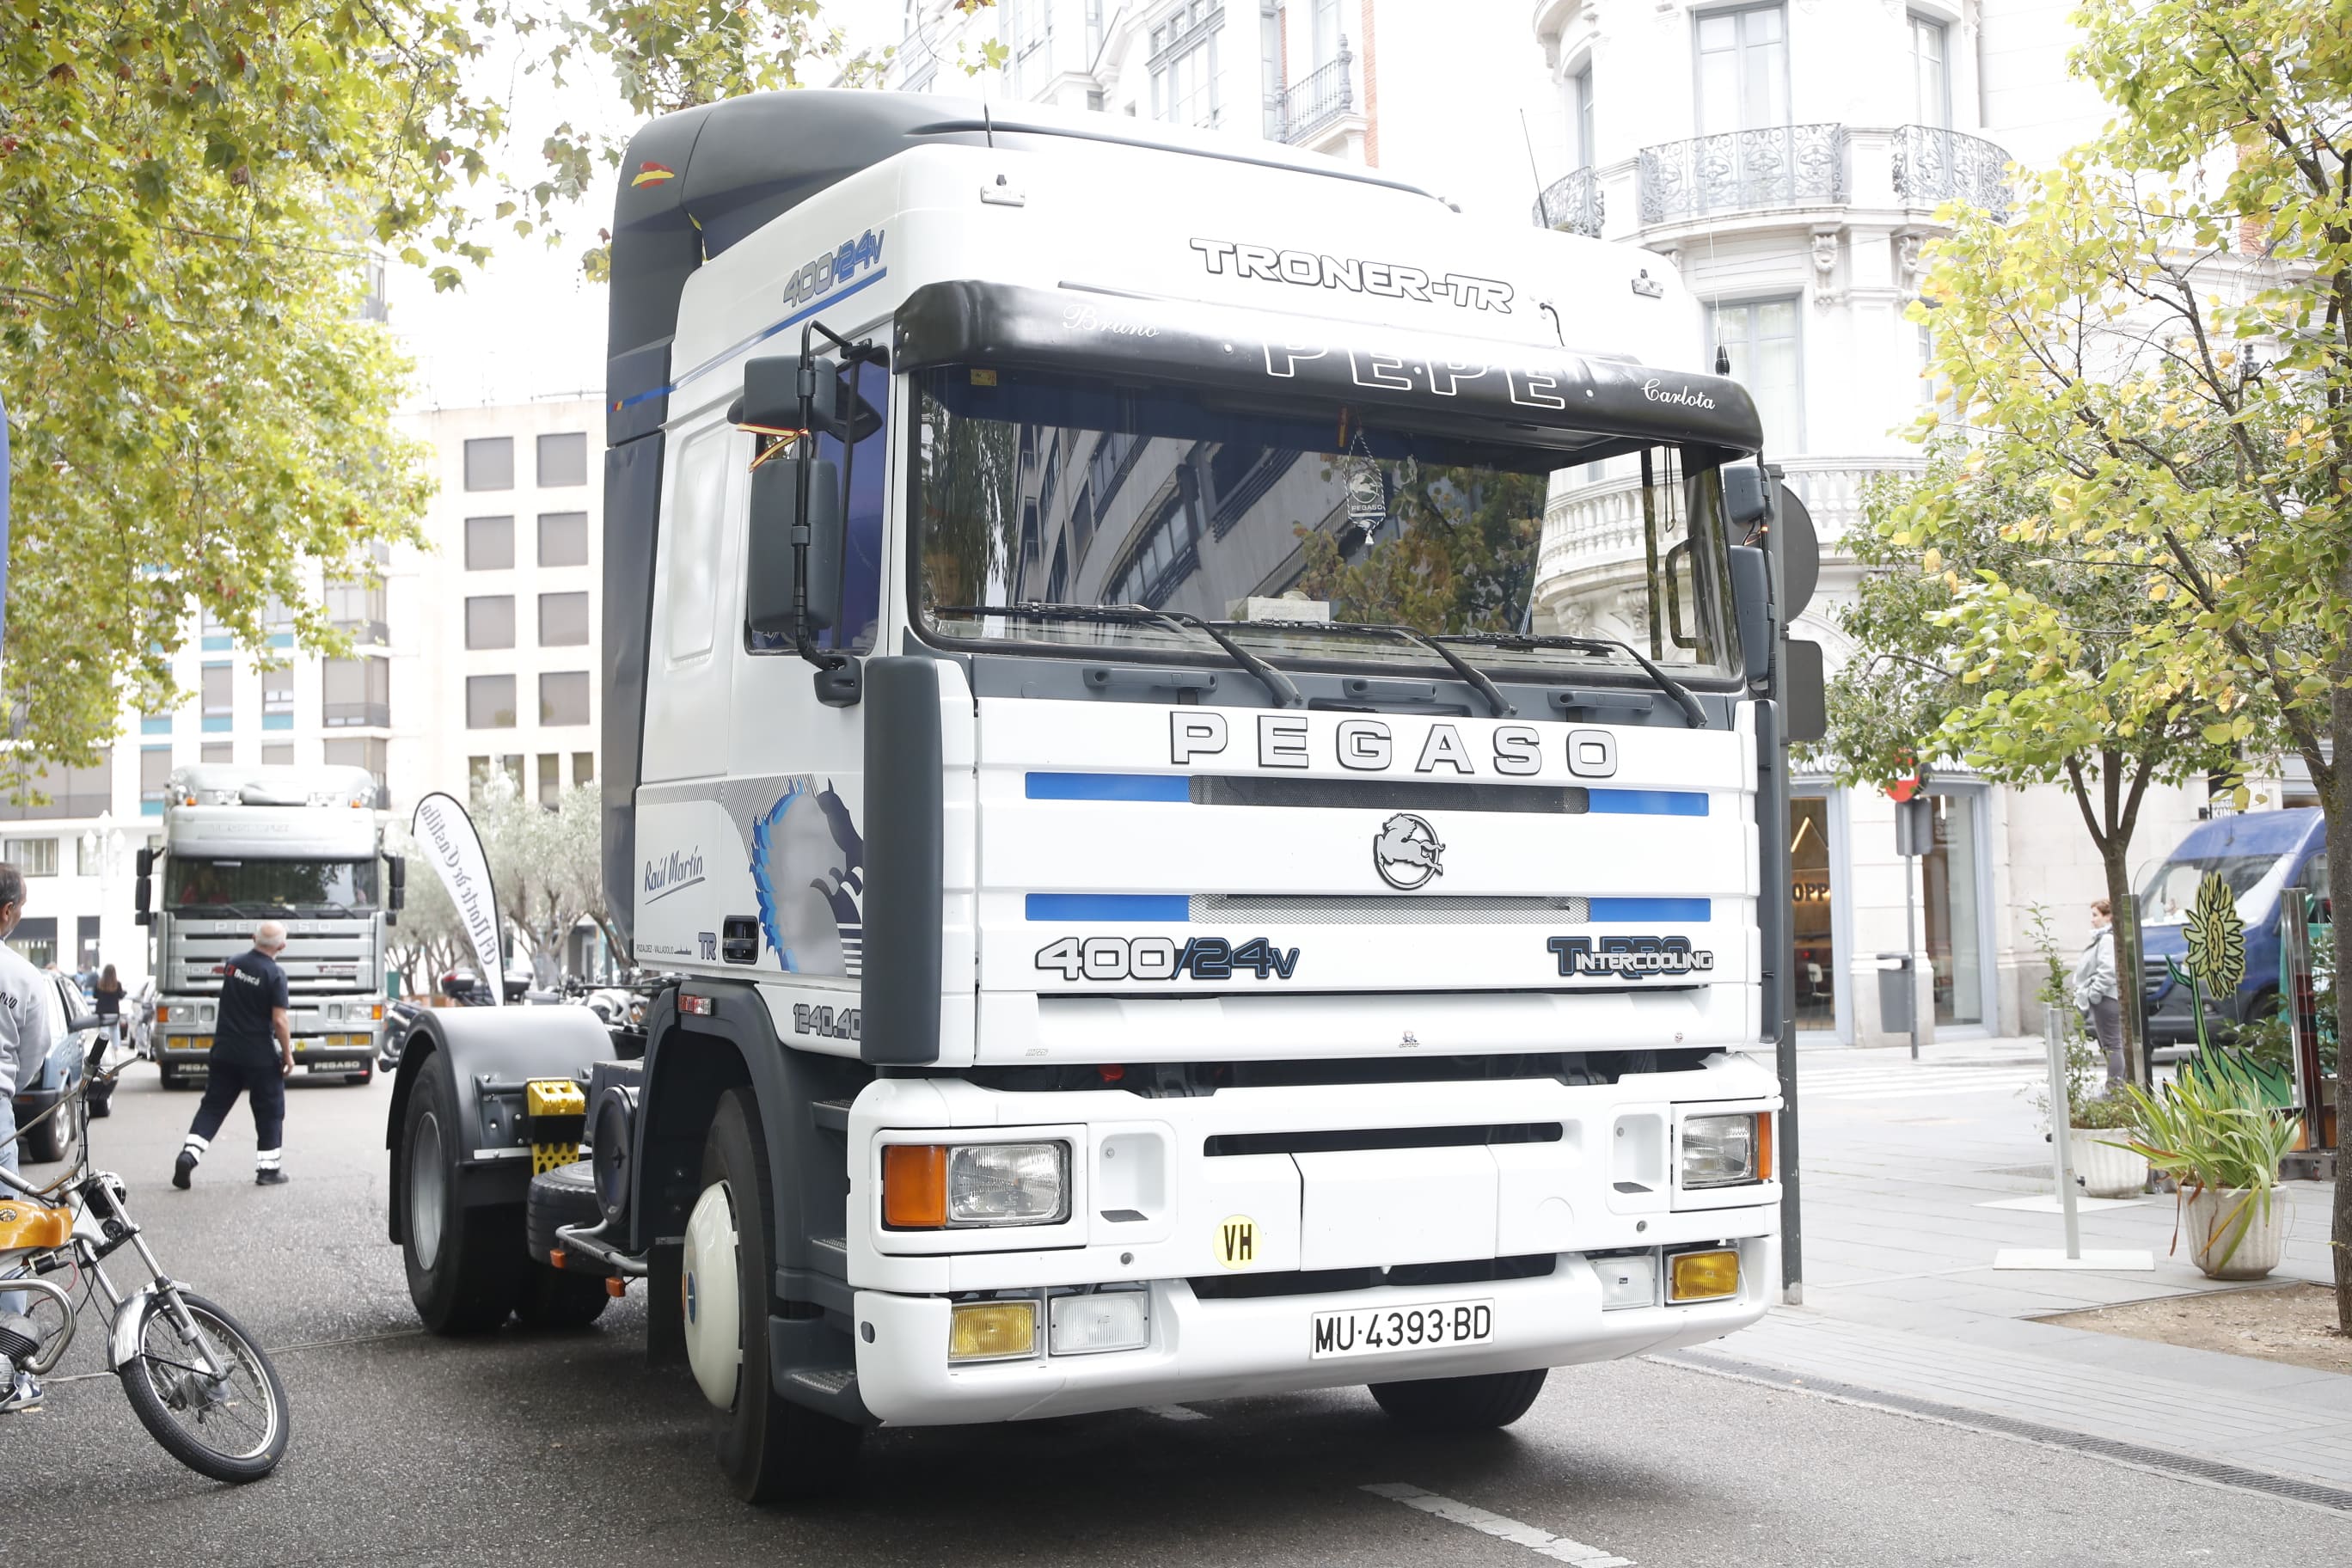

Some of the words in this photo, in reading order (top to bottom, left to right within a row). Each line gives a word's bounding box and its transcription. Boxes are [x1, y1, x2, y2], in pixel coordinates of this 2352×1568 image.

[1190, 237, 1515, 315] TRONER-TR
[1063, 303, 1161, 338] Bruno
[1640, 378, 1716, 410] Carlota
[1169, 710, 1619, 778] PEGASO
[644, 855, 668, 893] Raúl
[668, 844, 703, 885] Martín
[698, 932, 717, 960] TR
[1547, 935, 1693, 980] TURBO
[1575, 951, 1714, 971] INTERCOOLING
[315, 1060, 360, 1070] PEGASO
[1223, 1224, 1253, 1261] VH
